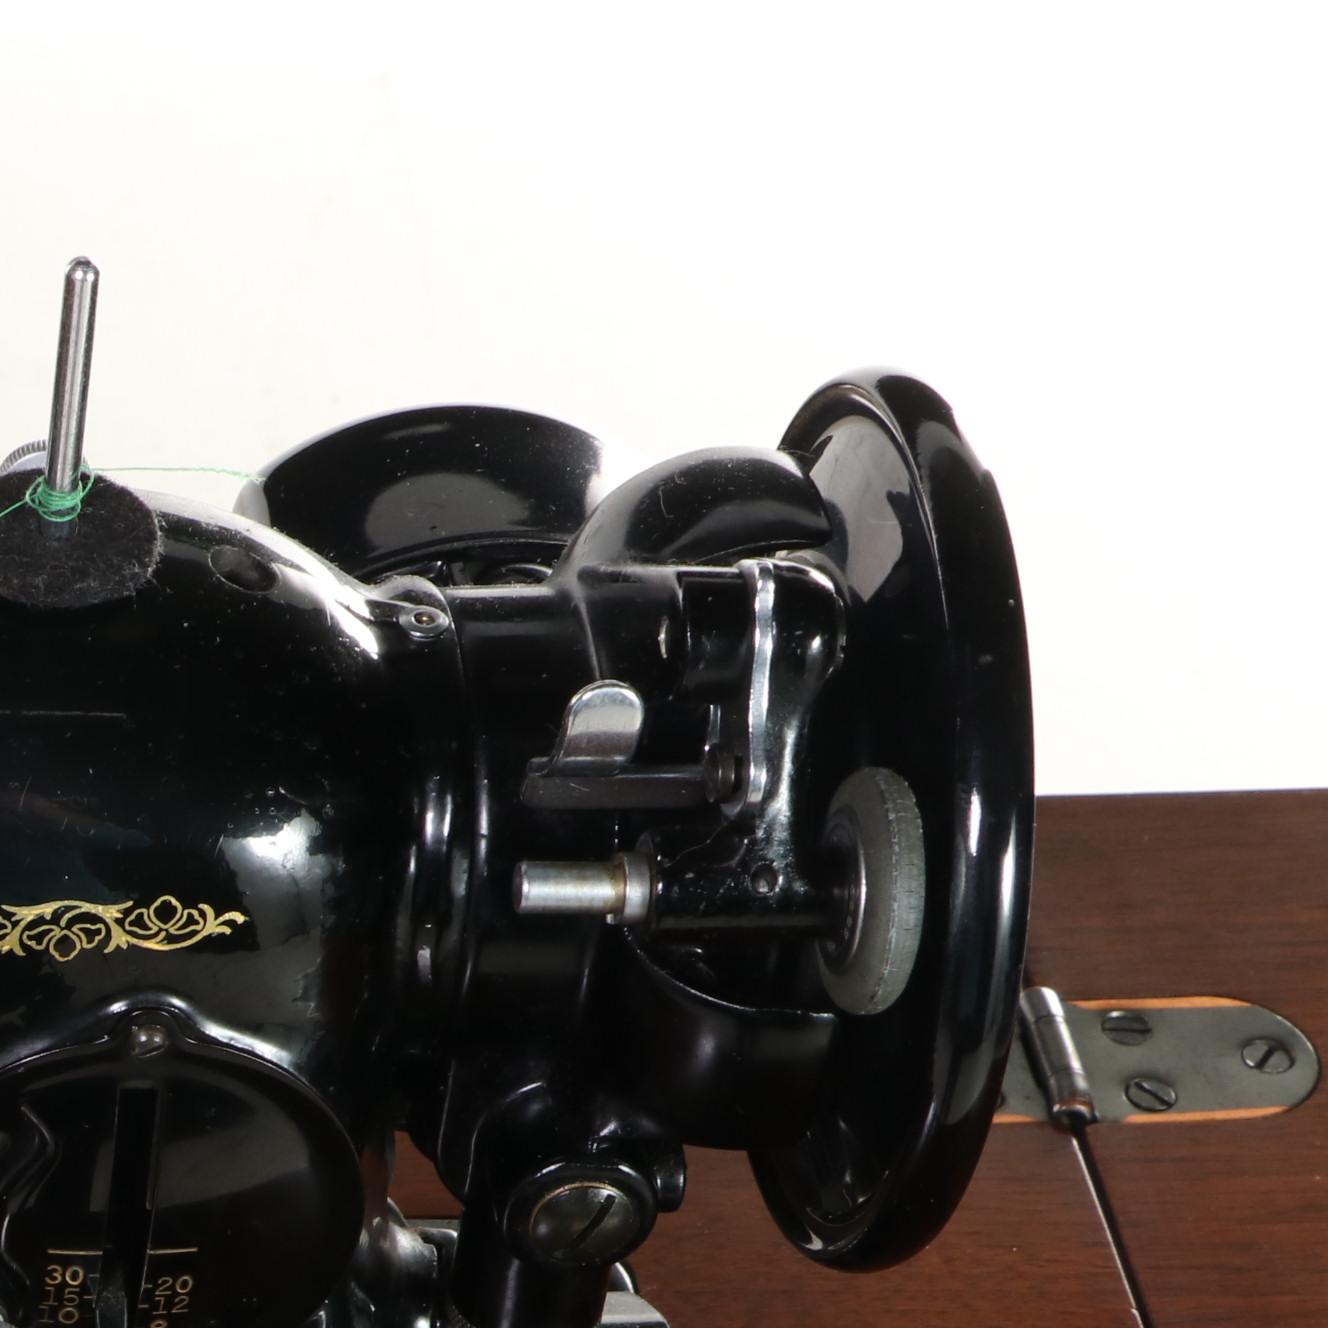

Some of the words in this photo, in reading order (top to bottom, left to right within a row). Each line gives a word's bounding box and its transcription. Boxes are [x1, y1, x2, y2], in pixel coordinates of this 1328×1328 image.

[44, 1264, 85, 1286] 30
[154, 1275, 193, 1295] 20
[43, 1287, 80, 1306] 15
[151, 1296, 190, 1315] 12
[37, 1305, 80, 1324] 10
